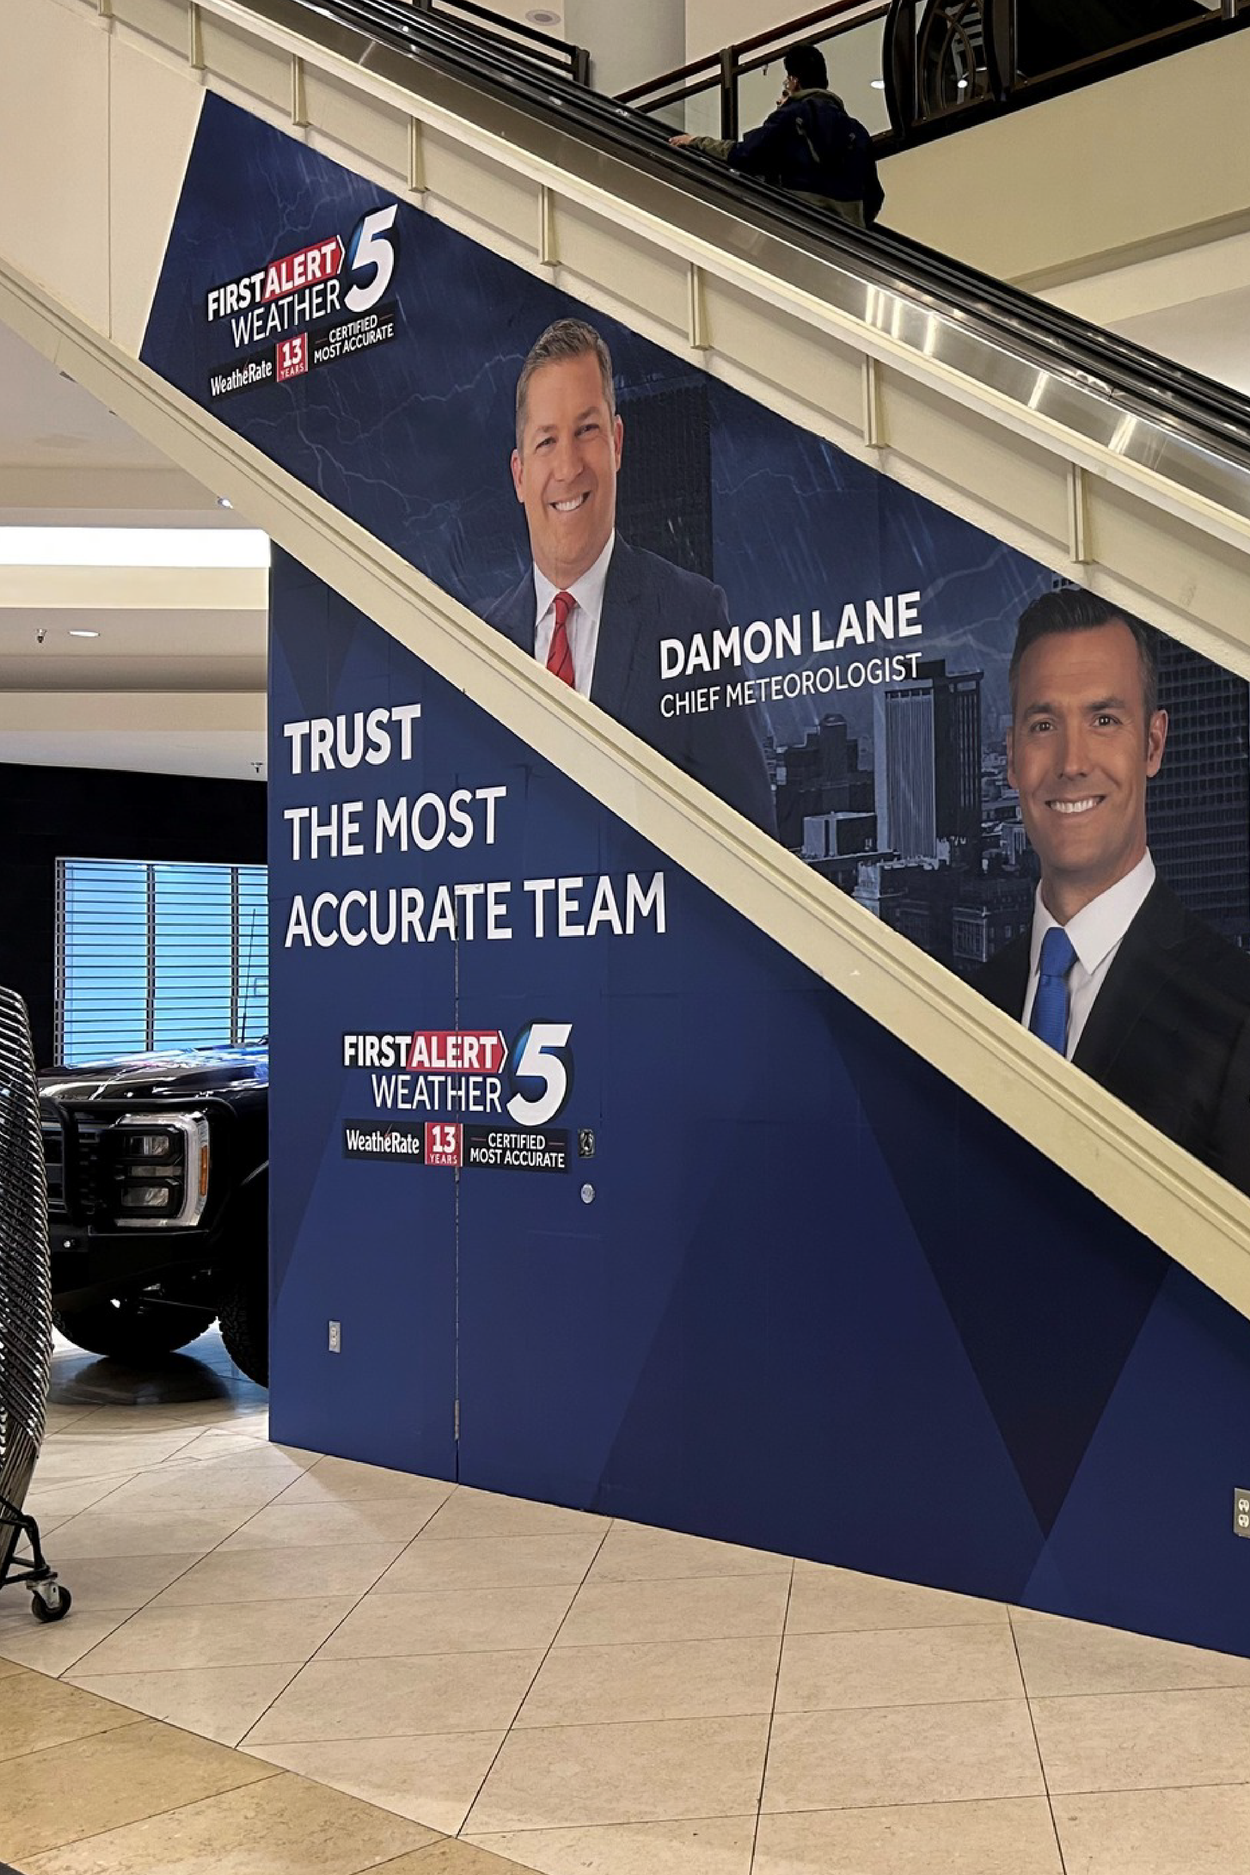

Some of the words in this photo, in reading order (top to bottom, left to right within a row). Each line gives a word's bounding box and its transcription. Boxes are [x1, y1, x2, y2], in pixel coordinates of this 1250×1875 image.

[344, 203, 398, 312] 5
[231, 279, 341, 348] WEATHER
[328, 314, 378, 344] CERTIFIED
[282, 337, 302, 367] 13
[314, 345, 340, 363] MOST
[342, 323, 394, 354] ACCURATE
[280, 364, 305, 379] YEARS
[660, 614, 801, 680] DAMON
[811, 591, 923, 652] LANE
[660, 686, 720, 718] CHIEF
[725, 652, 922, 708] METEOROLOGIST
[284, 703, 421, 775] TRUST
[283, 801, 364, 861] THE
[375, 785, 506, 853] MOST
[284, 881, 512, 948] ACCURATE
[523, 871, 666, 938] TEAM
[371, 1074, 502, 1113] WEATHER
[506, 1023, 573, 1127] 5
[429, 1153, 458, 1165] YEARS
[432, 1125, 457, 1153] 13
[470, 1148, 502, 1165] MOST
[504, 1151, 565, 1168] ACCURATE
[488, 1133, 546, 1150] CERTIFIED
